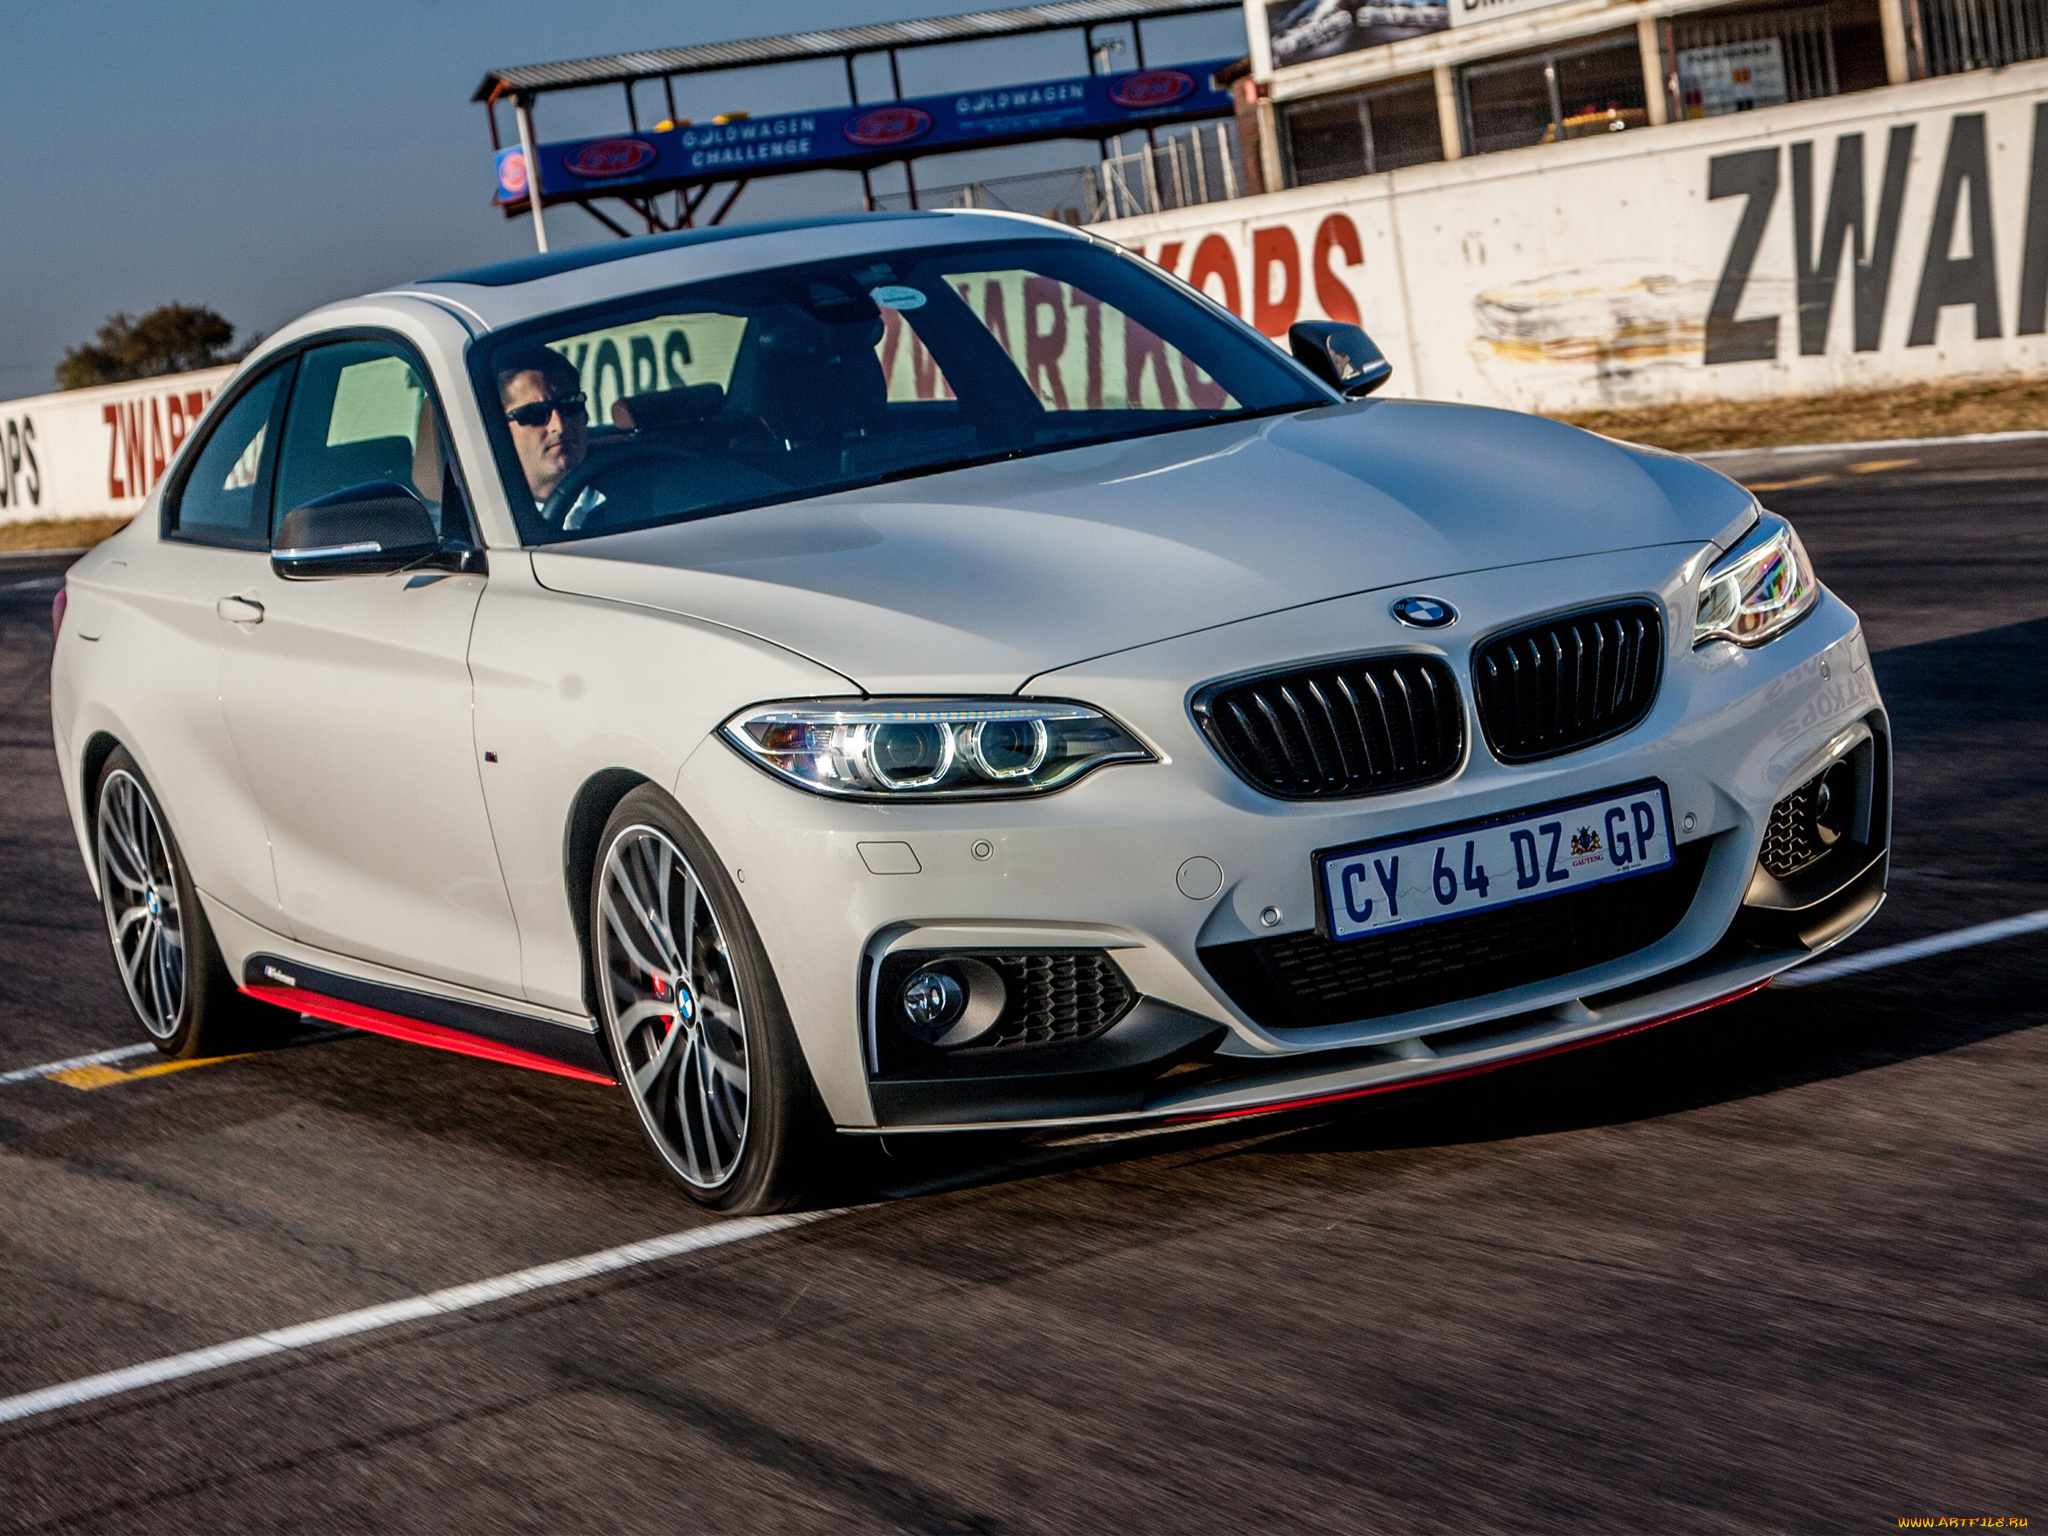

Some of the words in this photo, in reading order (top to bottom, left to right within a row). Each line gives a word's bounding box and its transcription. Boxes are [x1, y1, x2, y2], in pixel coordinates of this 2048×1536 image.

[692, 138, 812, 168] CHALLENGE
[1341, 855, 1399, 923] CY
[1432, 840, 1490, 905] 64
[1509, 821, 1570, 890] DZ
[1604, 801, 1655, 866] GP
[1572, 853, 1604, 868] GAUTENG
